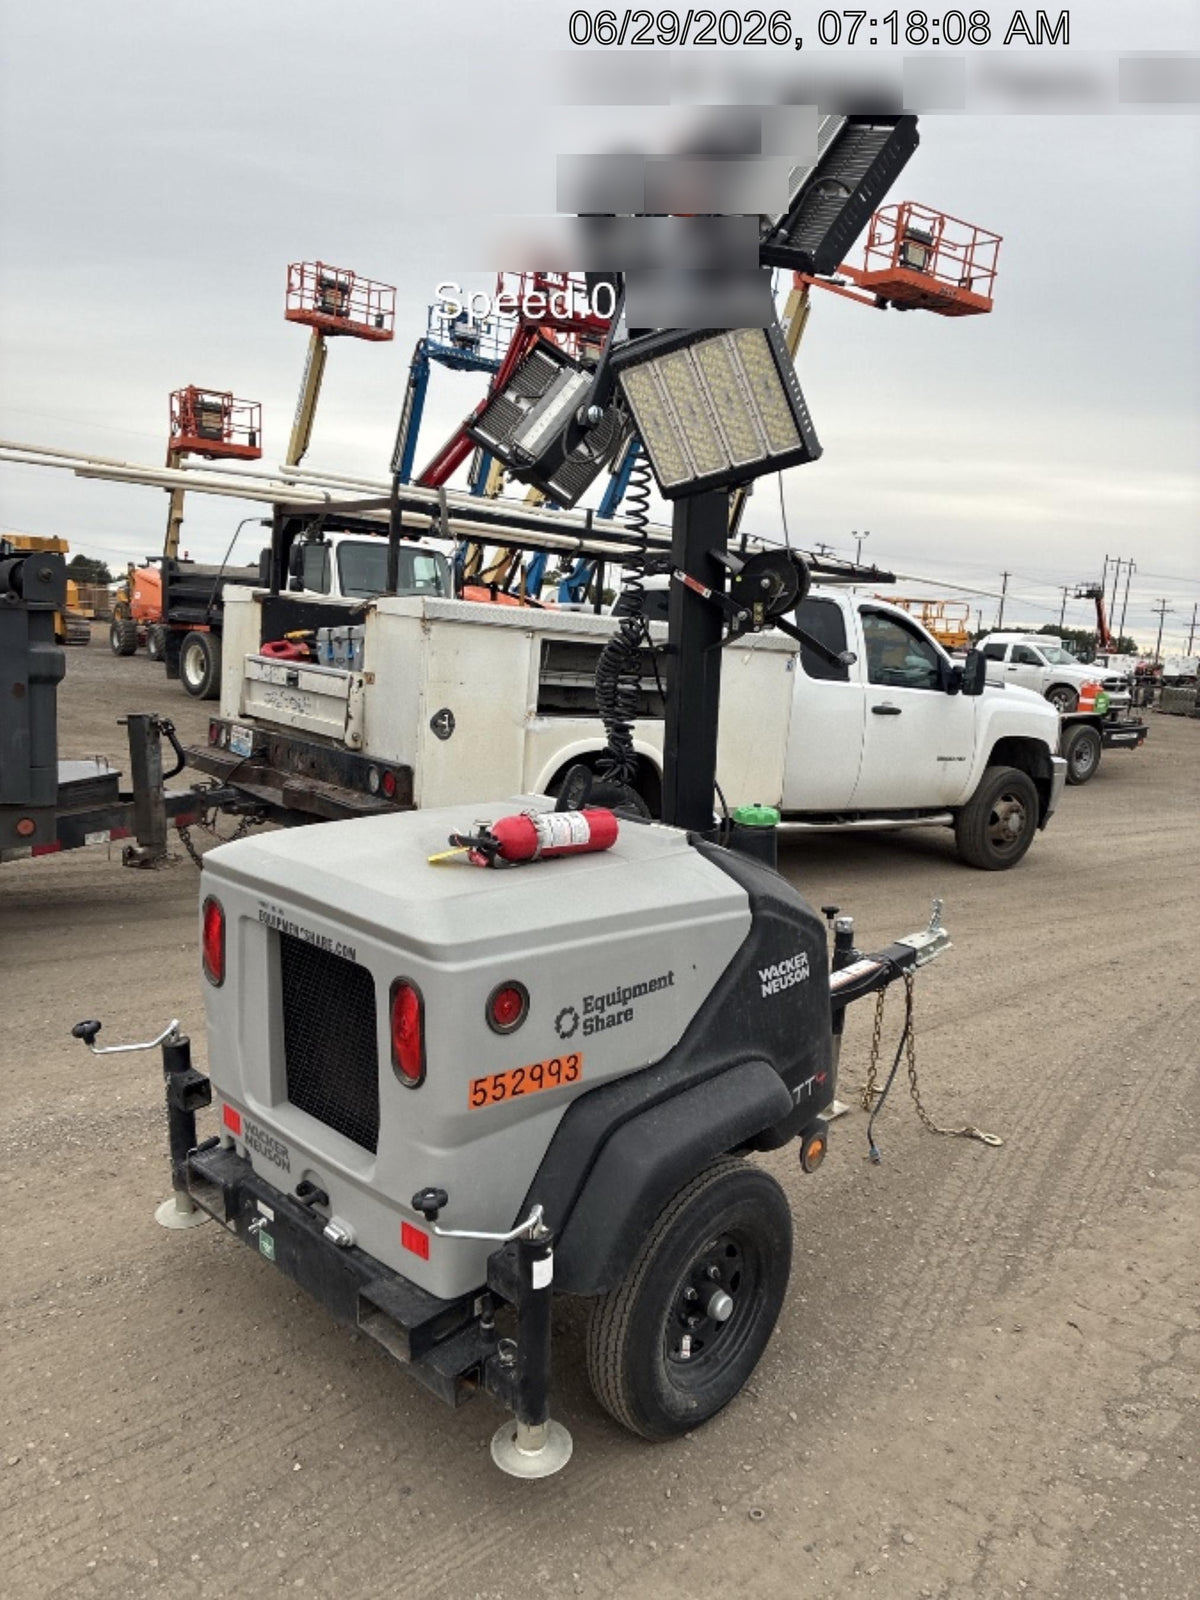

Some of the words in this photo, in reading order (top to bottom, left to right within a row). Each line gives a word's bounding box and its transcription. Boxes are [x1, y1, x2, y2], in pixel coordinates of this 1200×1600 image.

[758, 950, 808, 982] WACKER
[761, 964, 810, 998] NEUSON
[582, 970, 675, 1014] Equipment
[582, 1007, 634, 1036] Share
[472, 1054, 579, 1107] 552993
[243, 1117, 289, 1160] WACKER
[245, 1132, 291, 1174] NEUSON
